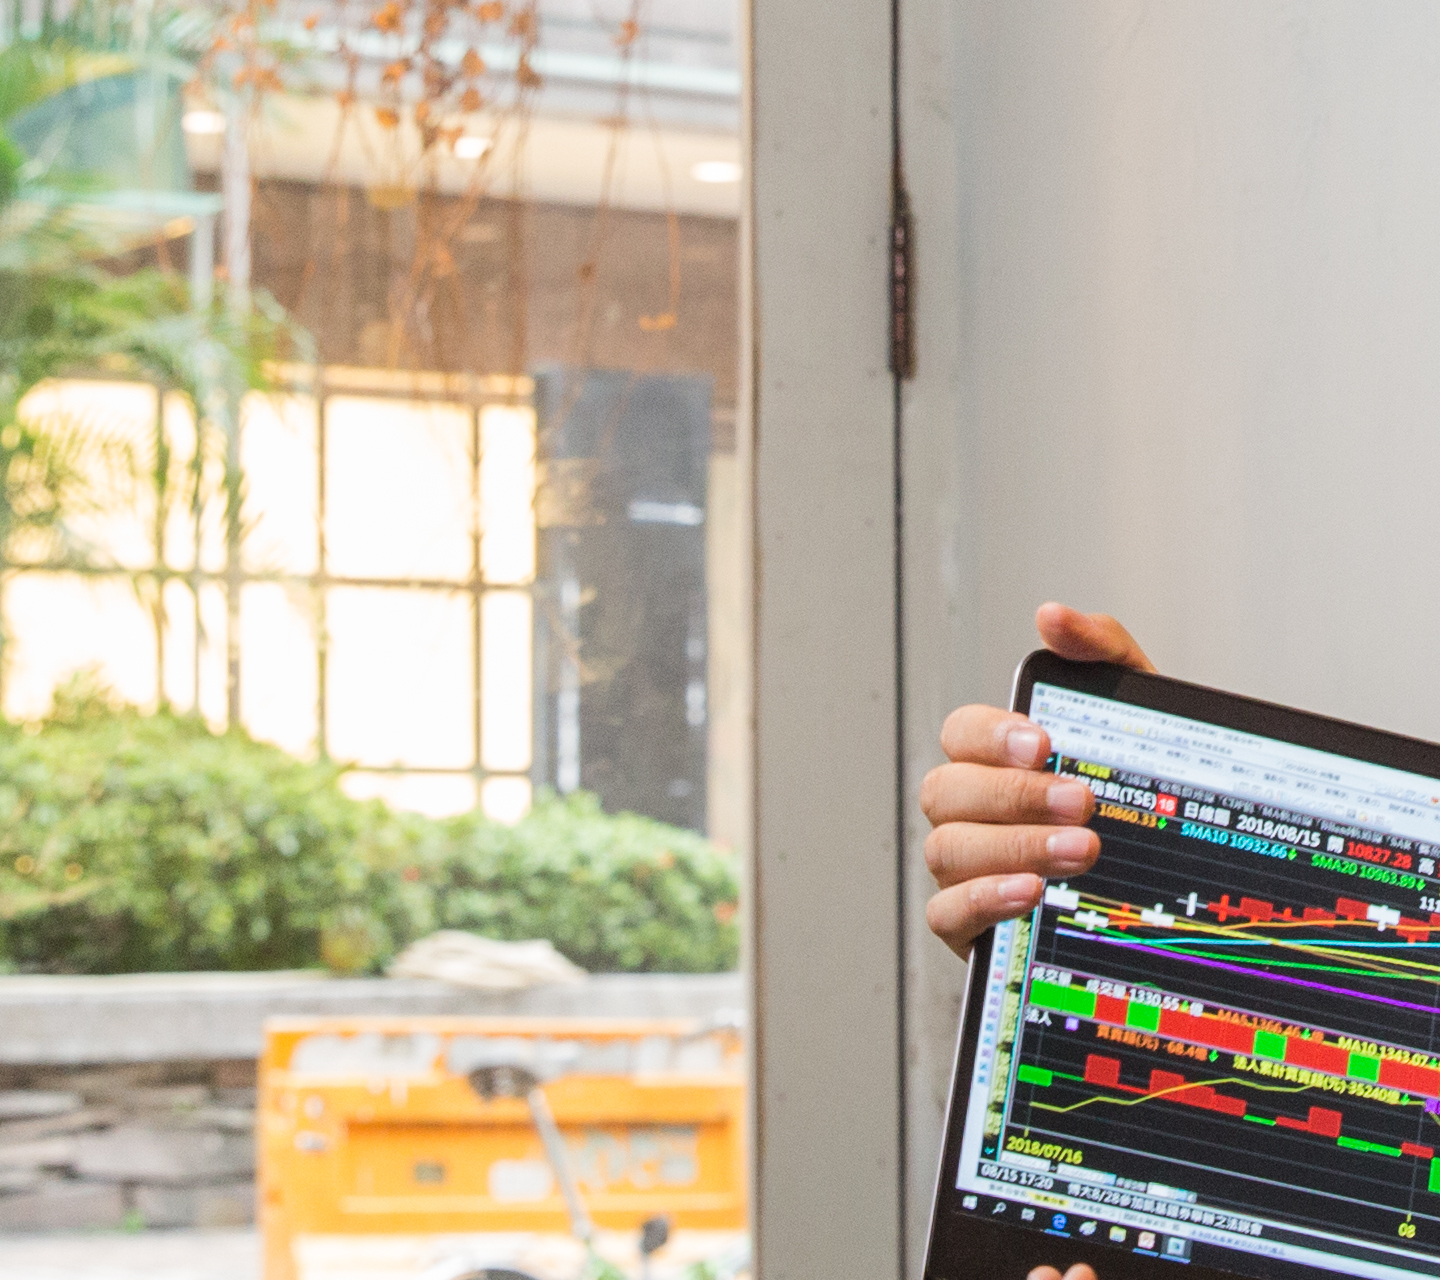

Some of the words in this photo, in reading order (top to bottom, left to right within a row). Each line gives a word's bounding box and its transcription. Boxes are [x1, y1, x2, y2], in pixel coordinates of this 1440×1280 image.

[1181, 822, 1228, 843] SMA10
[1237, 815, 1319, 846] 2018/08/15
[1348, 842, 1410, 868] 10827.28
[1312, 853, 1356, 874] SMA20
[1007, 1136, 1081, 1163] 2018/07/16
[981, 1163, 1017, 1181] 08/15
[1019, 1172, 1053, 1189] 17:20
[1398, 1222, 1415, 1237] 08
